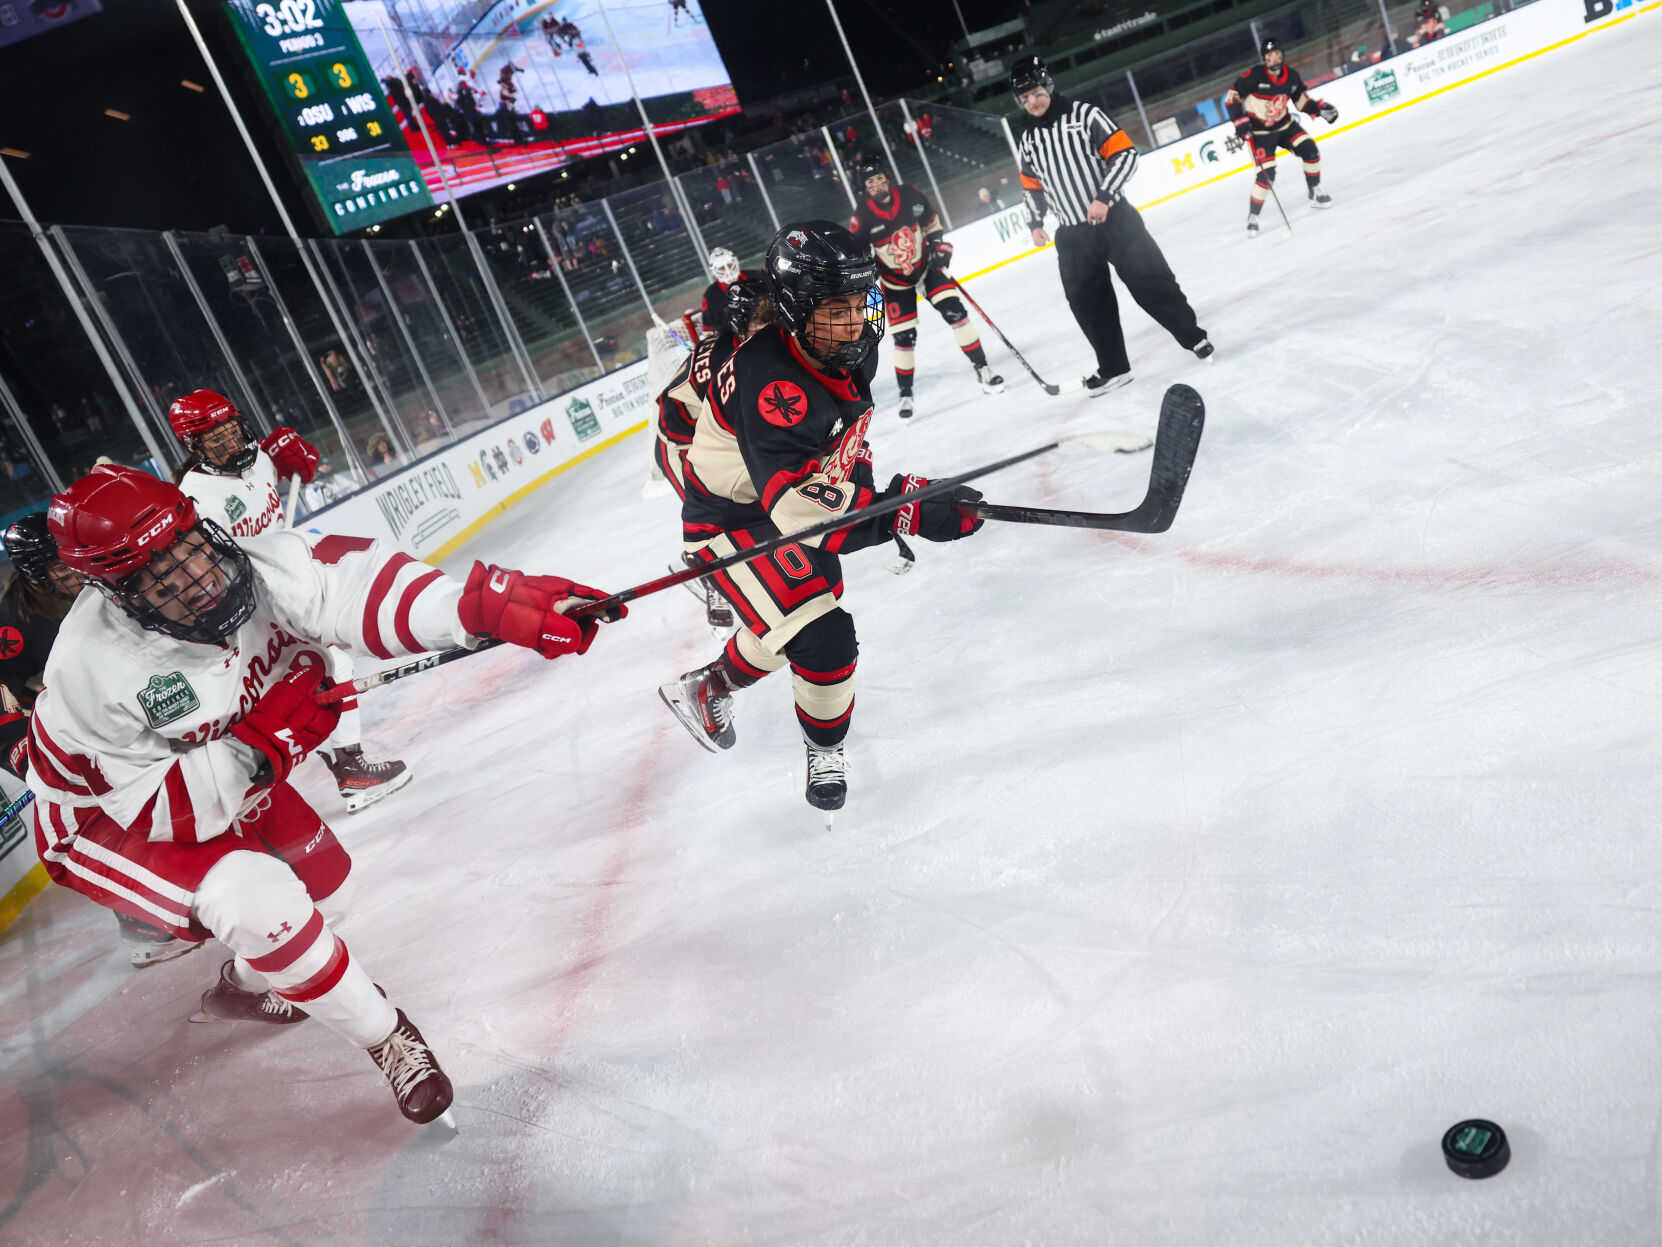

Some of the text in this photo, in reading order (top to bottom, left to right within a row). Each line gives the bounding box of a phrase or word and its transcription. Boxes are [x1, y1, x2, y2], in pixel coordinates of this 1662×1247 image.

[256, 0, 323, 36] 3:02
[288, 63, 352, 98] 3 3
[302, 103, 334, 126] OSU
[345, 93, 376, 114] WIS
[311, 135, 329, 151] 33
[366, 121, 382, 136] 31
[350, 169, 400, 191] Frozen
[334, 181, 420, 216] CONFINES
[210, 406, 229, 418] CCM
[268, 431, 300, 457] CCM
[375, 462, 461, 541] WRIGLEY FIELD
[137, 513, 174, 547] CCM
[218, 606, 246, 631] CCM
[542, 633, 571, 643] CCM
[380, 655, 440, 683] CCM
[145, 682, 186, 708] Frozen
[152, 690, 189, 713] CONFINES
